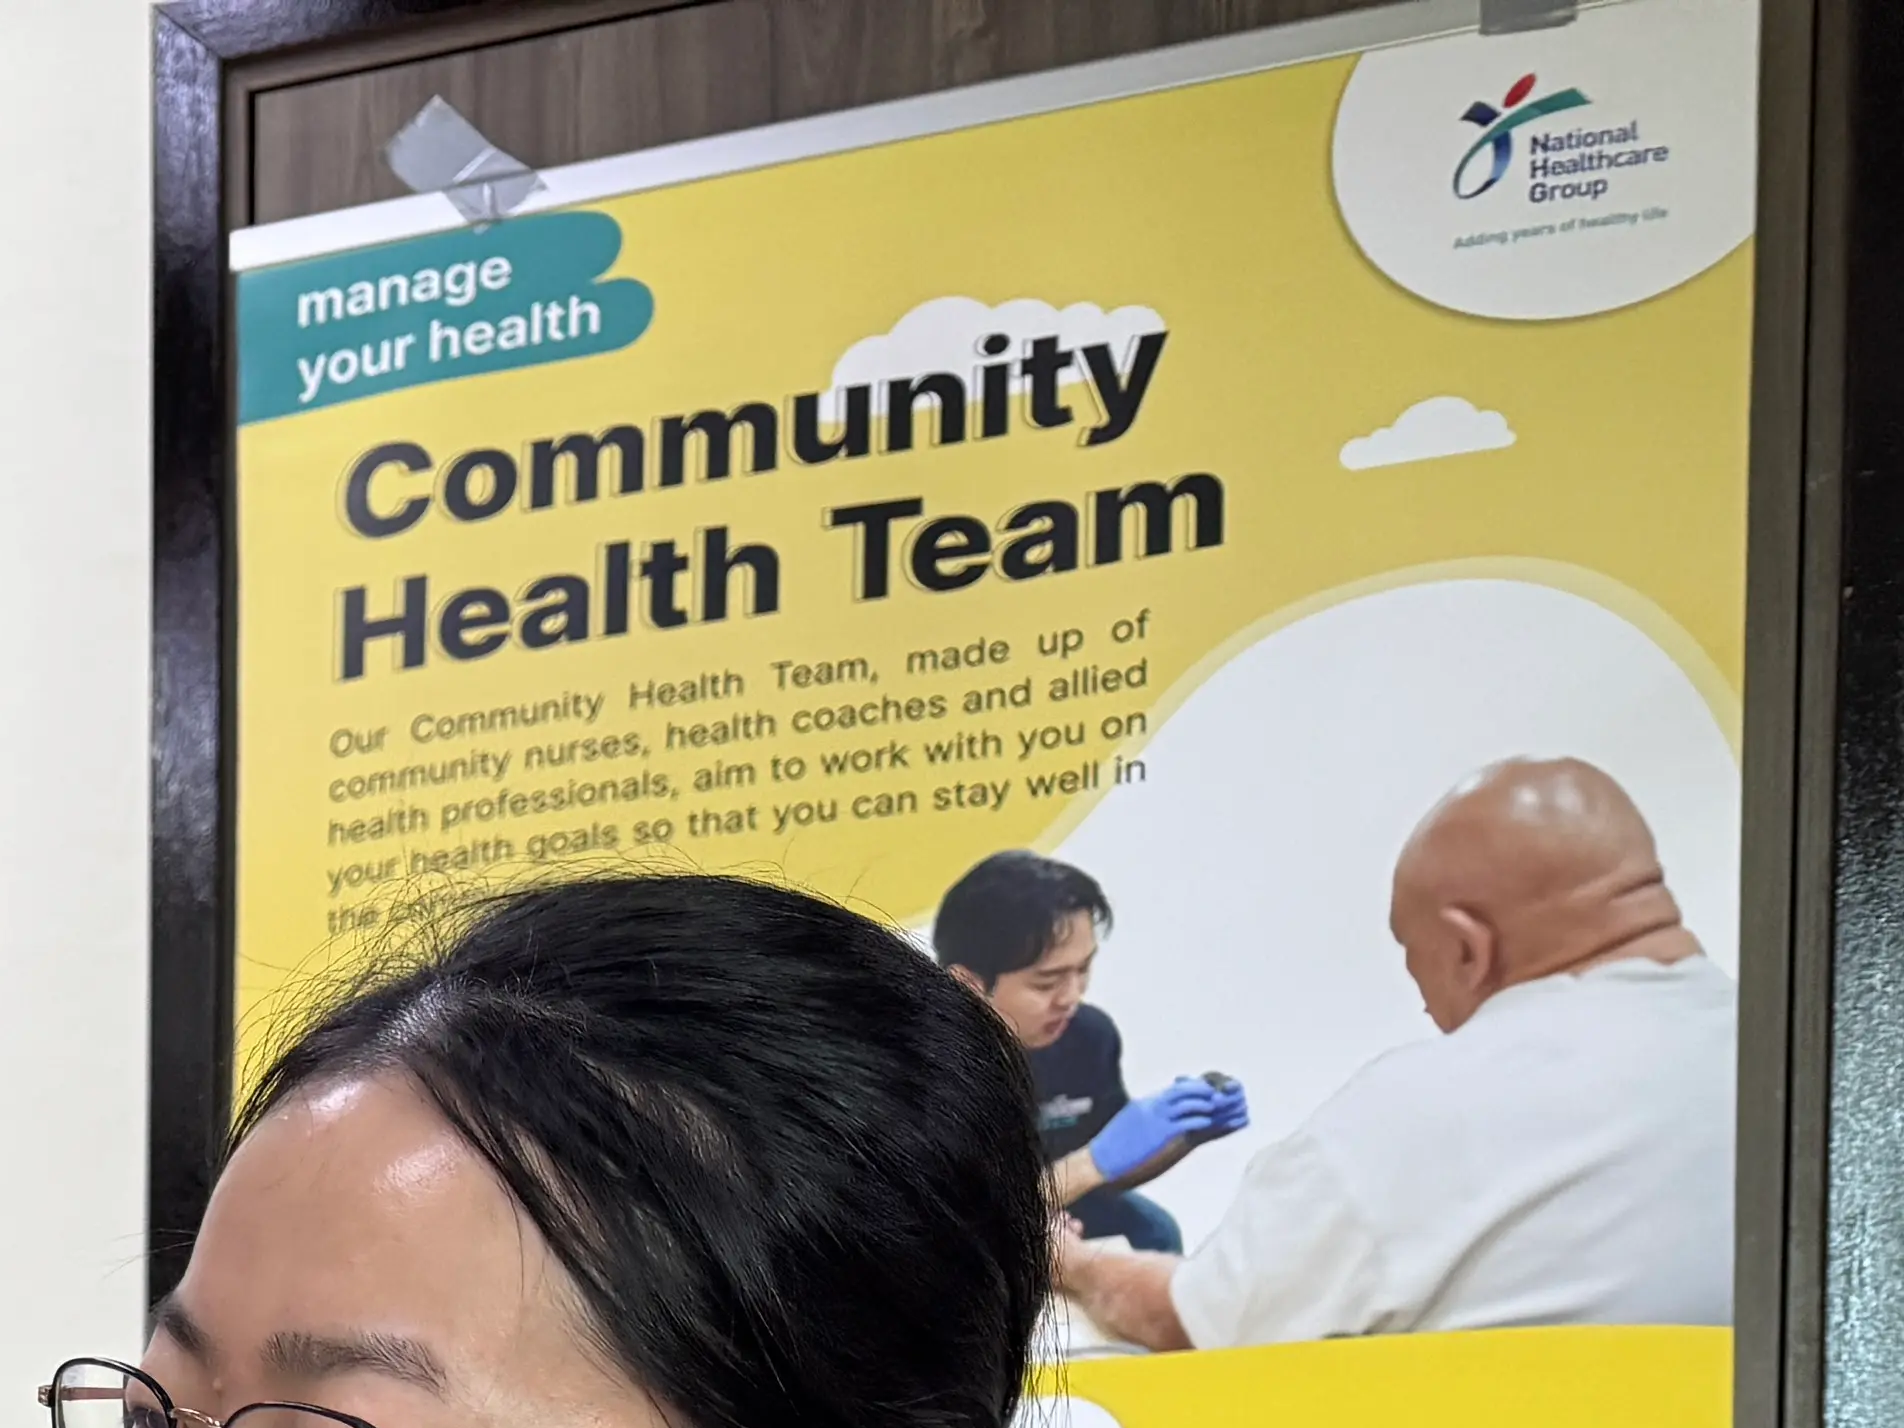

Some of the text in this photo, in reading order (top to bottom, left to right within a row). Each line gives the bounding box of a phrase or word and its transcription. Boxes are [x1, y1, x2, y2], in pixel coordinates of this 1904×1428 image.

[1528, 179, 1609, 205] Group
[1529, 143, 1669, 181] Healthcare
[1530, 120, 1640, 156] National
[297, 252, 512, 326] manage
[1452, 230, 1508, 251] Adding
[1512, 222, 1556, 244] years
[1560, 218, 1576, 233] of
[297, 295, 601, 403] your health
[338, 328, 1169, 541] Community
[332, 471, 1227, 684] Health Team
[328, 658, 1149, 804] community nurses, health coaches and allied
[329, 608, 1151, 758] Our Community Health Team, made up of
[327, 755, 1147, 898] your health goals so that you can stay well in
[328, 711, 1147, 847] health professionals, aim to work with you on
